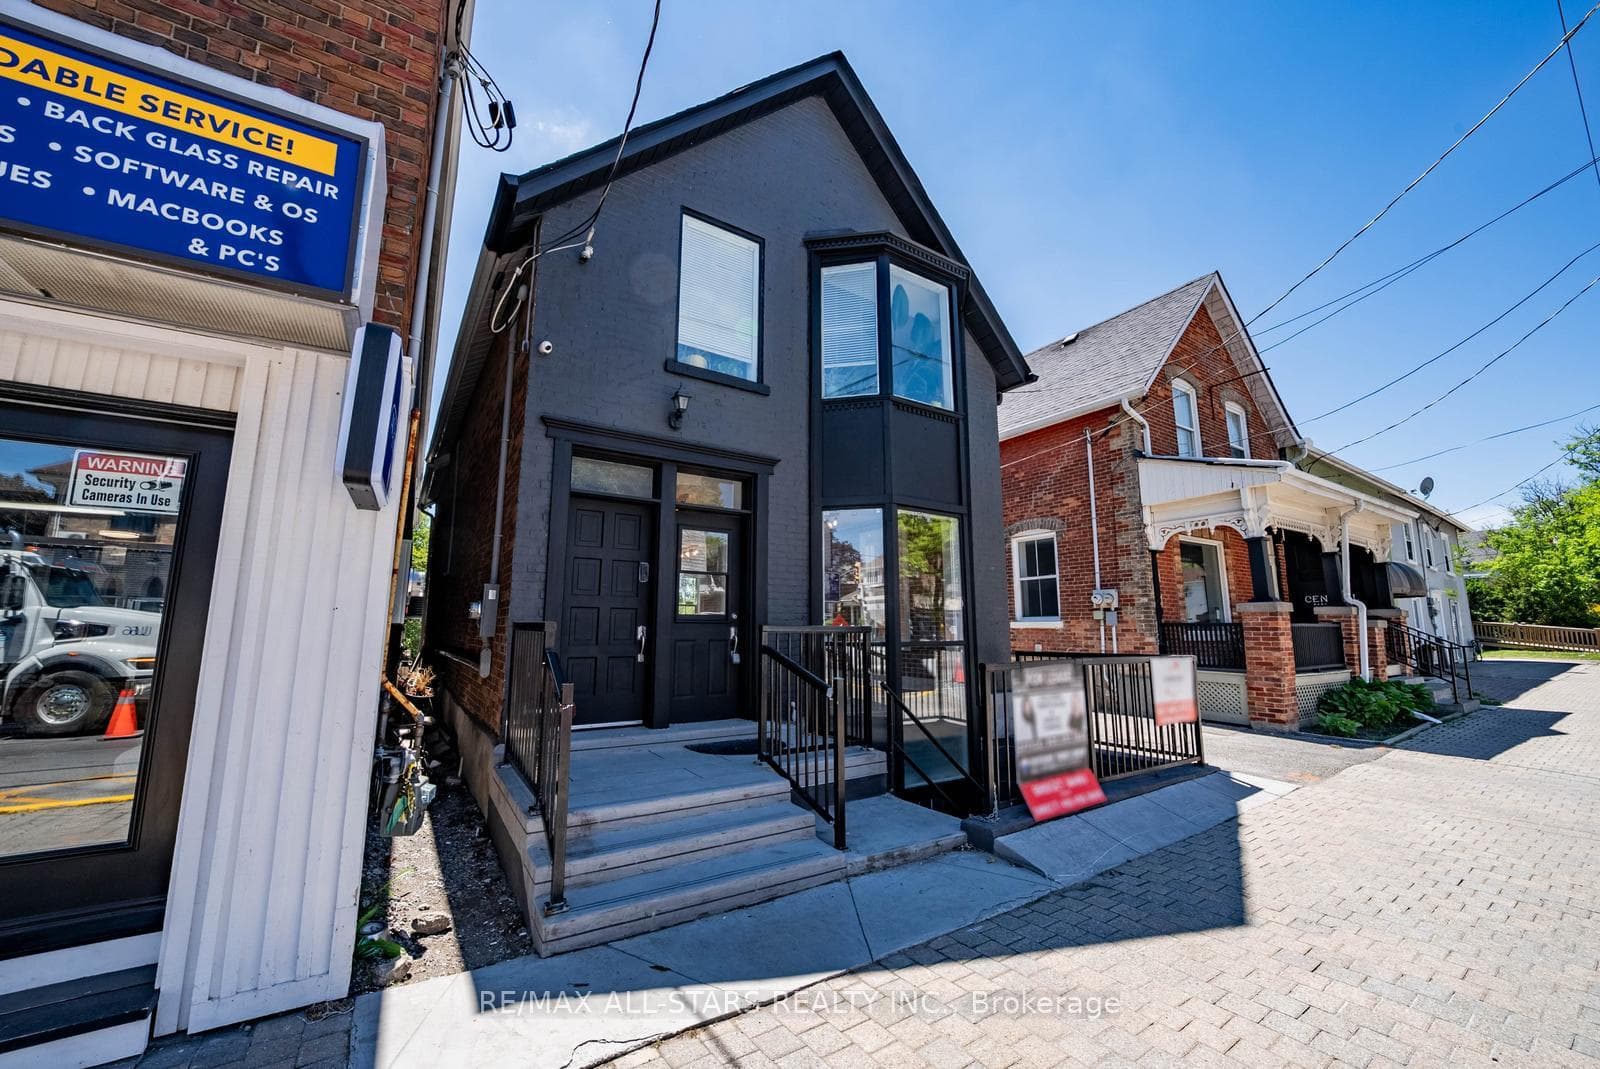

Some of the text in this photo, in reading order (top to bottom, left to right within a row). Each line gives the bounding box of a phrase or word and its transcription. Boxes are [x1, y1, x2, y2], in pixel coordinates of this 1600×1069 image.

[44, 100, 339, 200] BACK GLASS REPAIR
[138, 94, 295, 156] SERVICE!
[73, 145, 318, 224] SOFTWARE & OS
[107, 187, 284, 272] MACBOOKS & PC'S
[84, 473, 137, 491] Security
[87, 456, 170, 475] WARNIN
[81, 488, 171, 507] Cameras In Use
